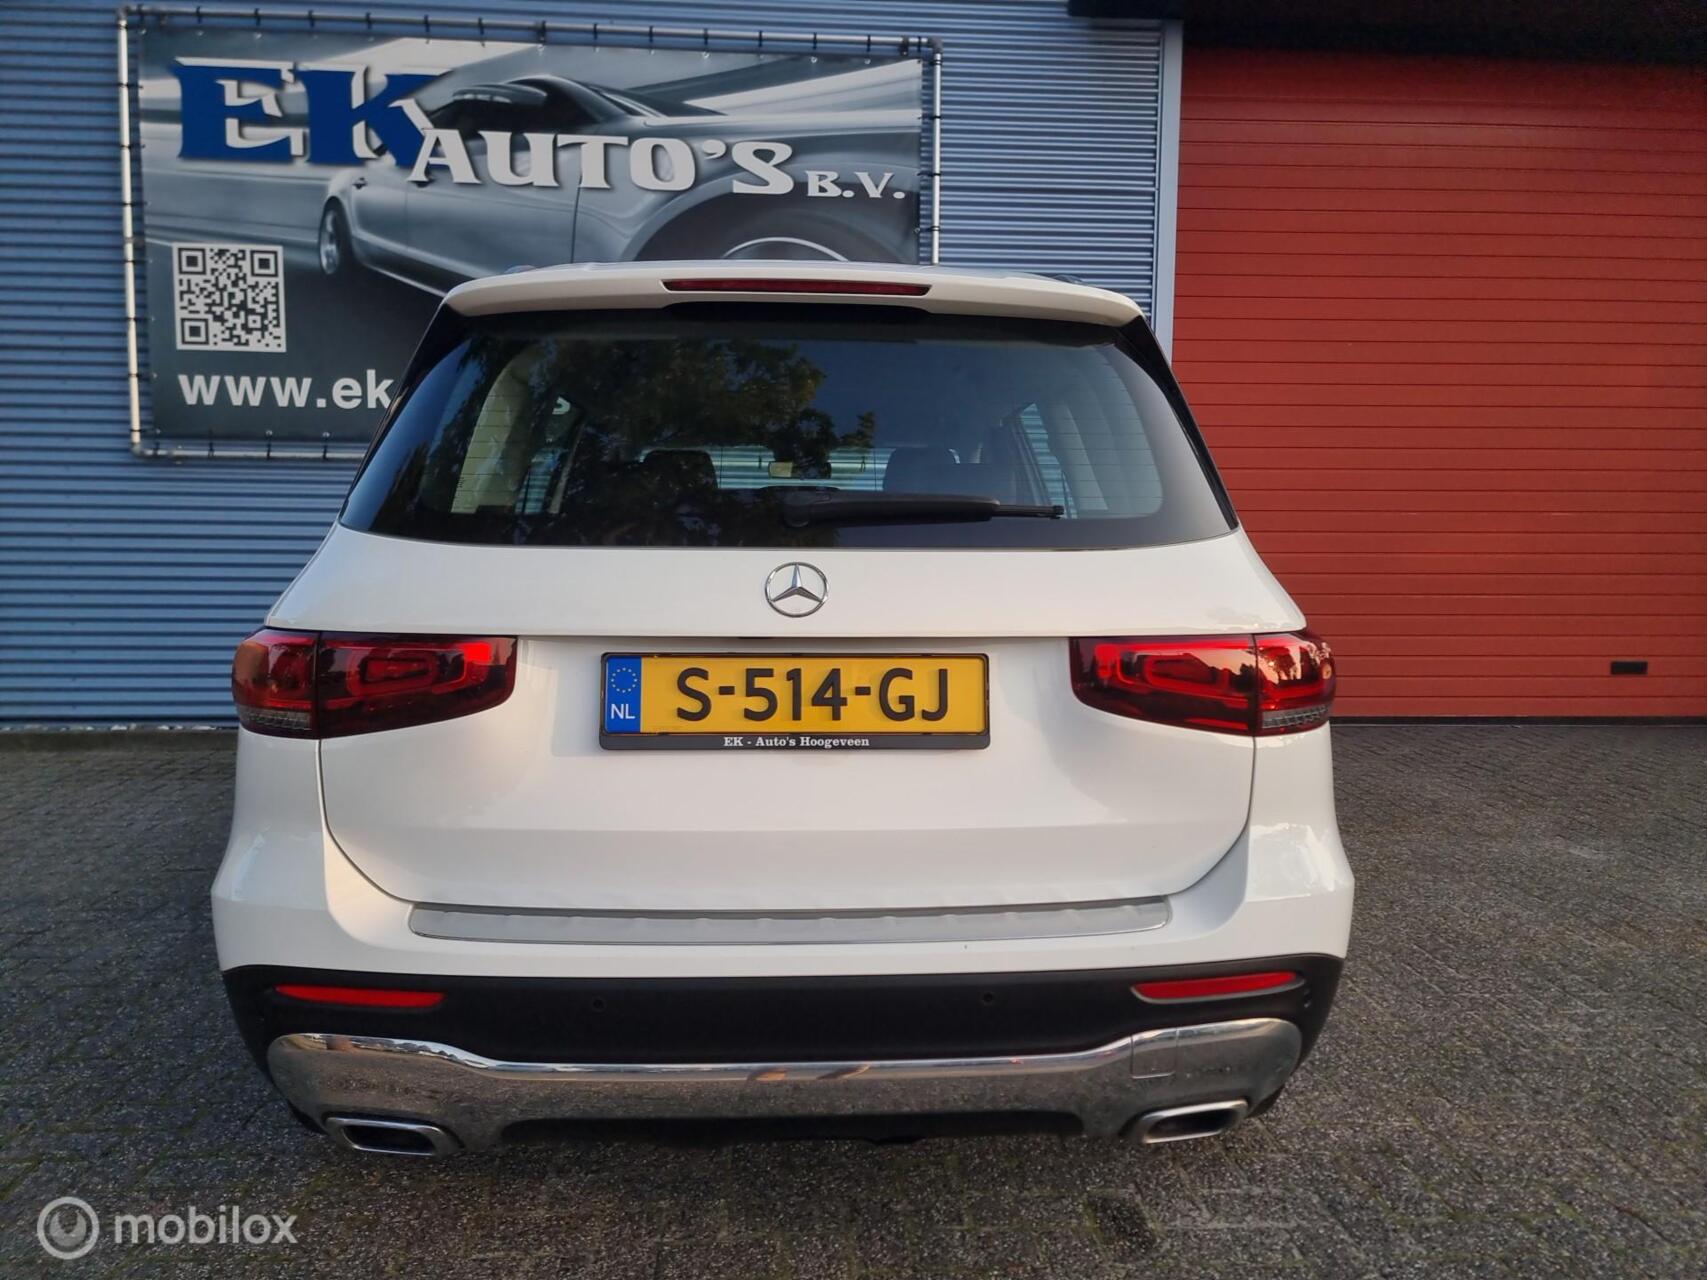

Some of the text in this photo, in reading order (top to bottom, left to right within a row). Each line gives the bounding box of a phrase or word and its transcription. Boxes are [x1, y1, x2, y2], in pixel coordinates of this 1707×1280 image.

[173, 57, 906, 200] EK AUTO'S B.V.
[610, 703, 636, 720] NL
[676, 666, 949, 722] S-514-GJ
[723, 736, 744, 747] EK
[755, 736, 796, 747] Auto's
[799, 736, 870, 748] Hoogeveen
